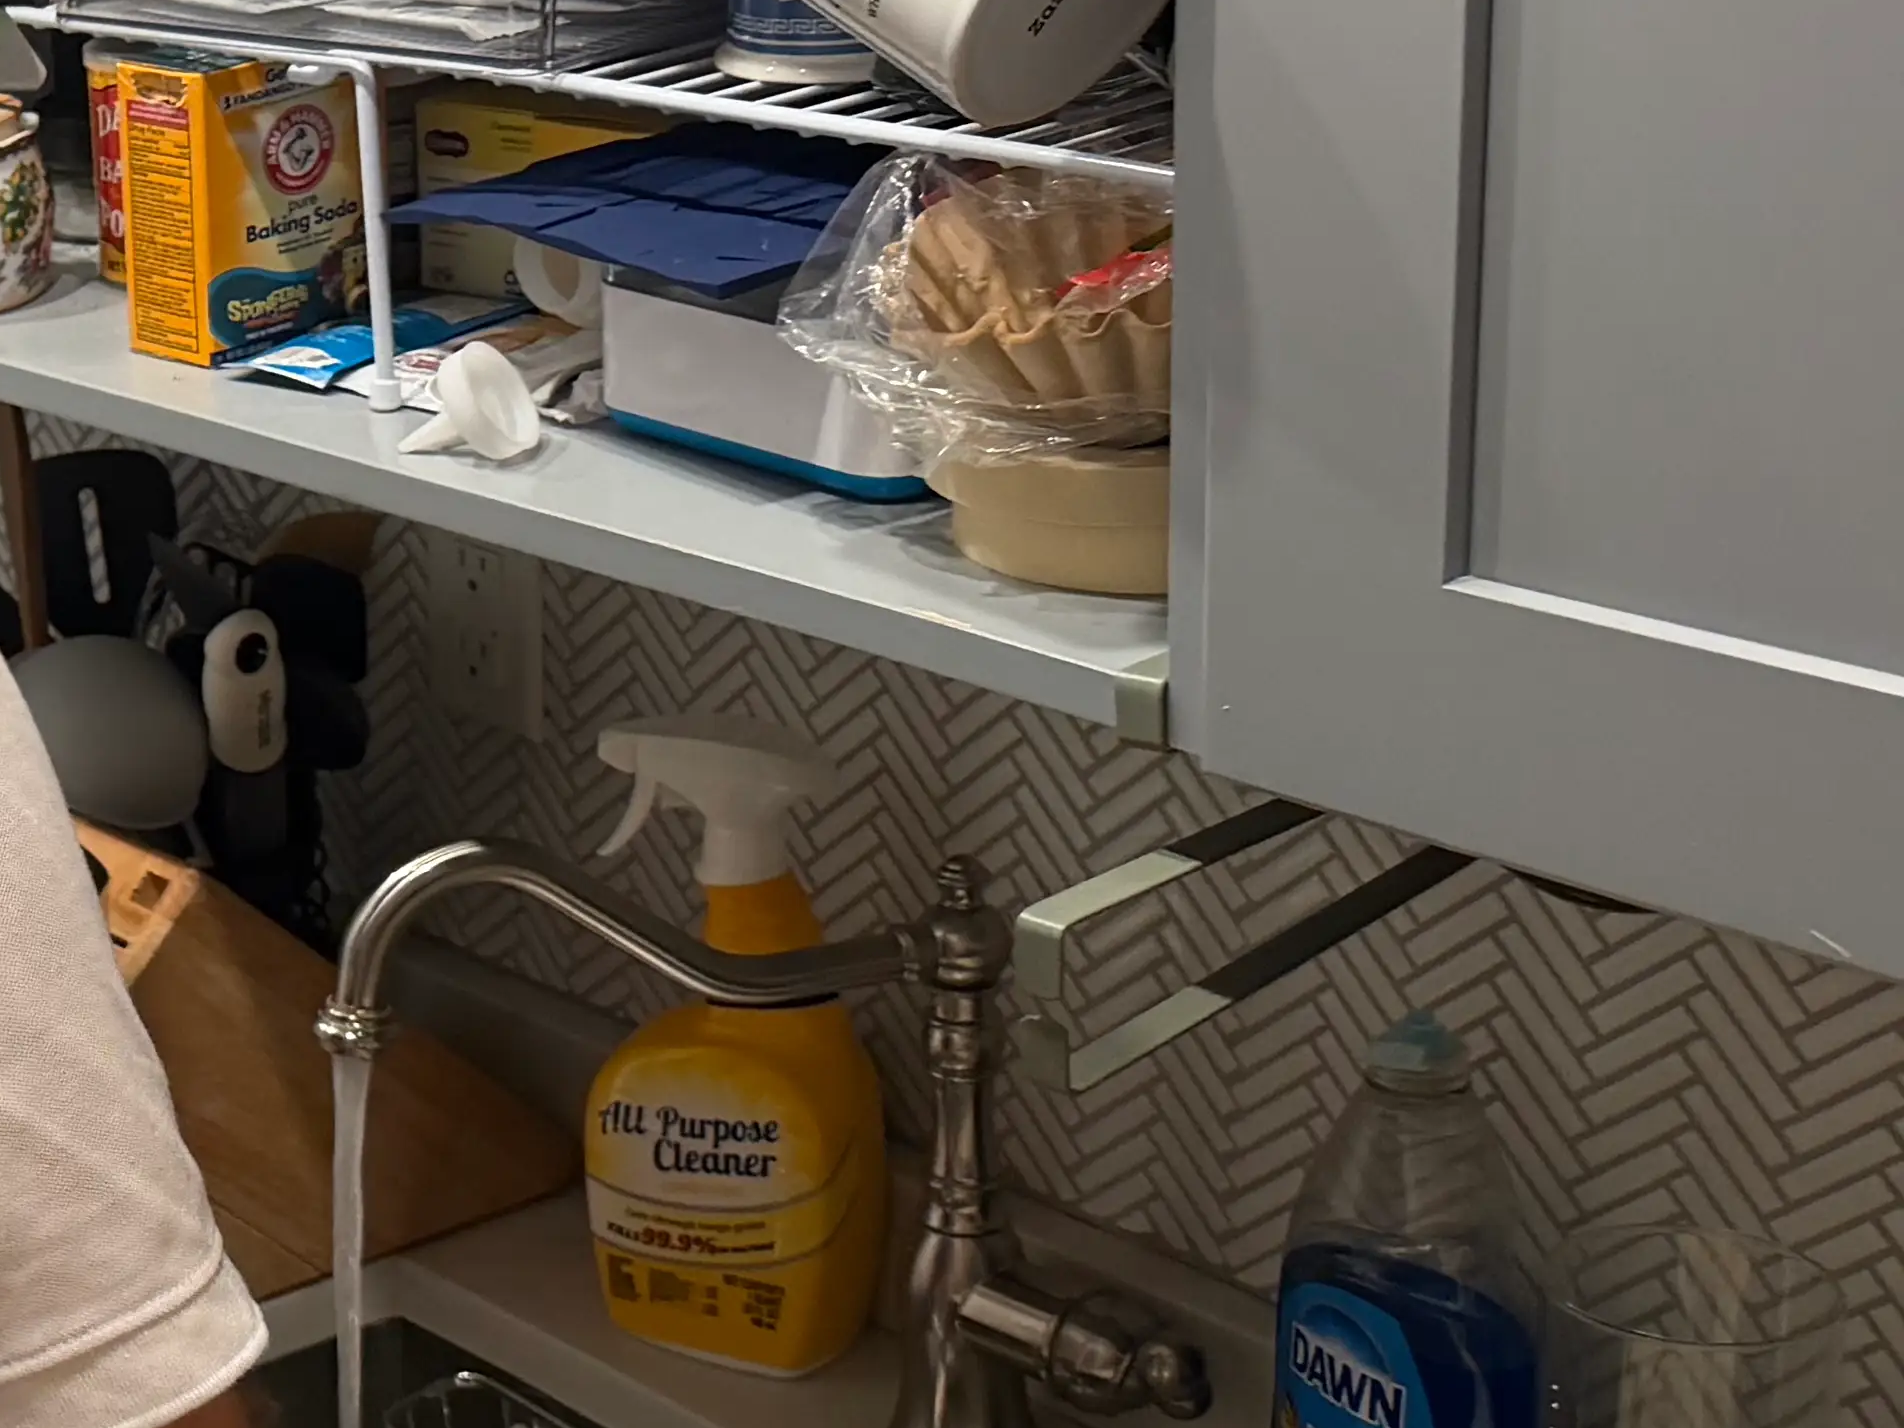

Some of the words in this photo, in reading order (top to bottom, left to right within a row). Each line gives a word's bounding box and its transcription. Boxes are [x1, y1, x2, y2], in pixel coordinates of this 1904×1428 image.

[246, 213, 310, 244] Baking
[313, 199, 359, 223] Soda
[288, 194, 318, 216] pure
[598, 1100, 648, 1135] All
[656, 1105, 781, 1148] Purpose
[654, 1138, 777, 1178] Cleaner
[642, 1226, 718, 1255] 99.9%
